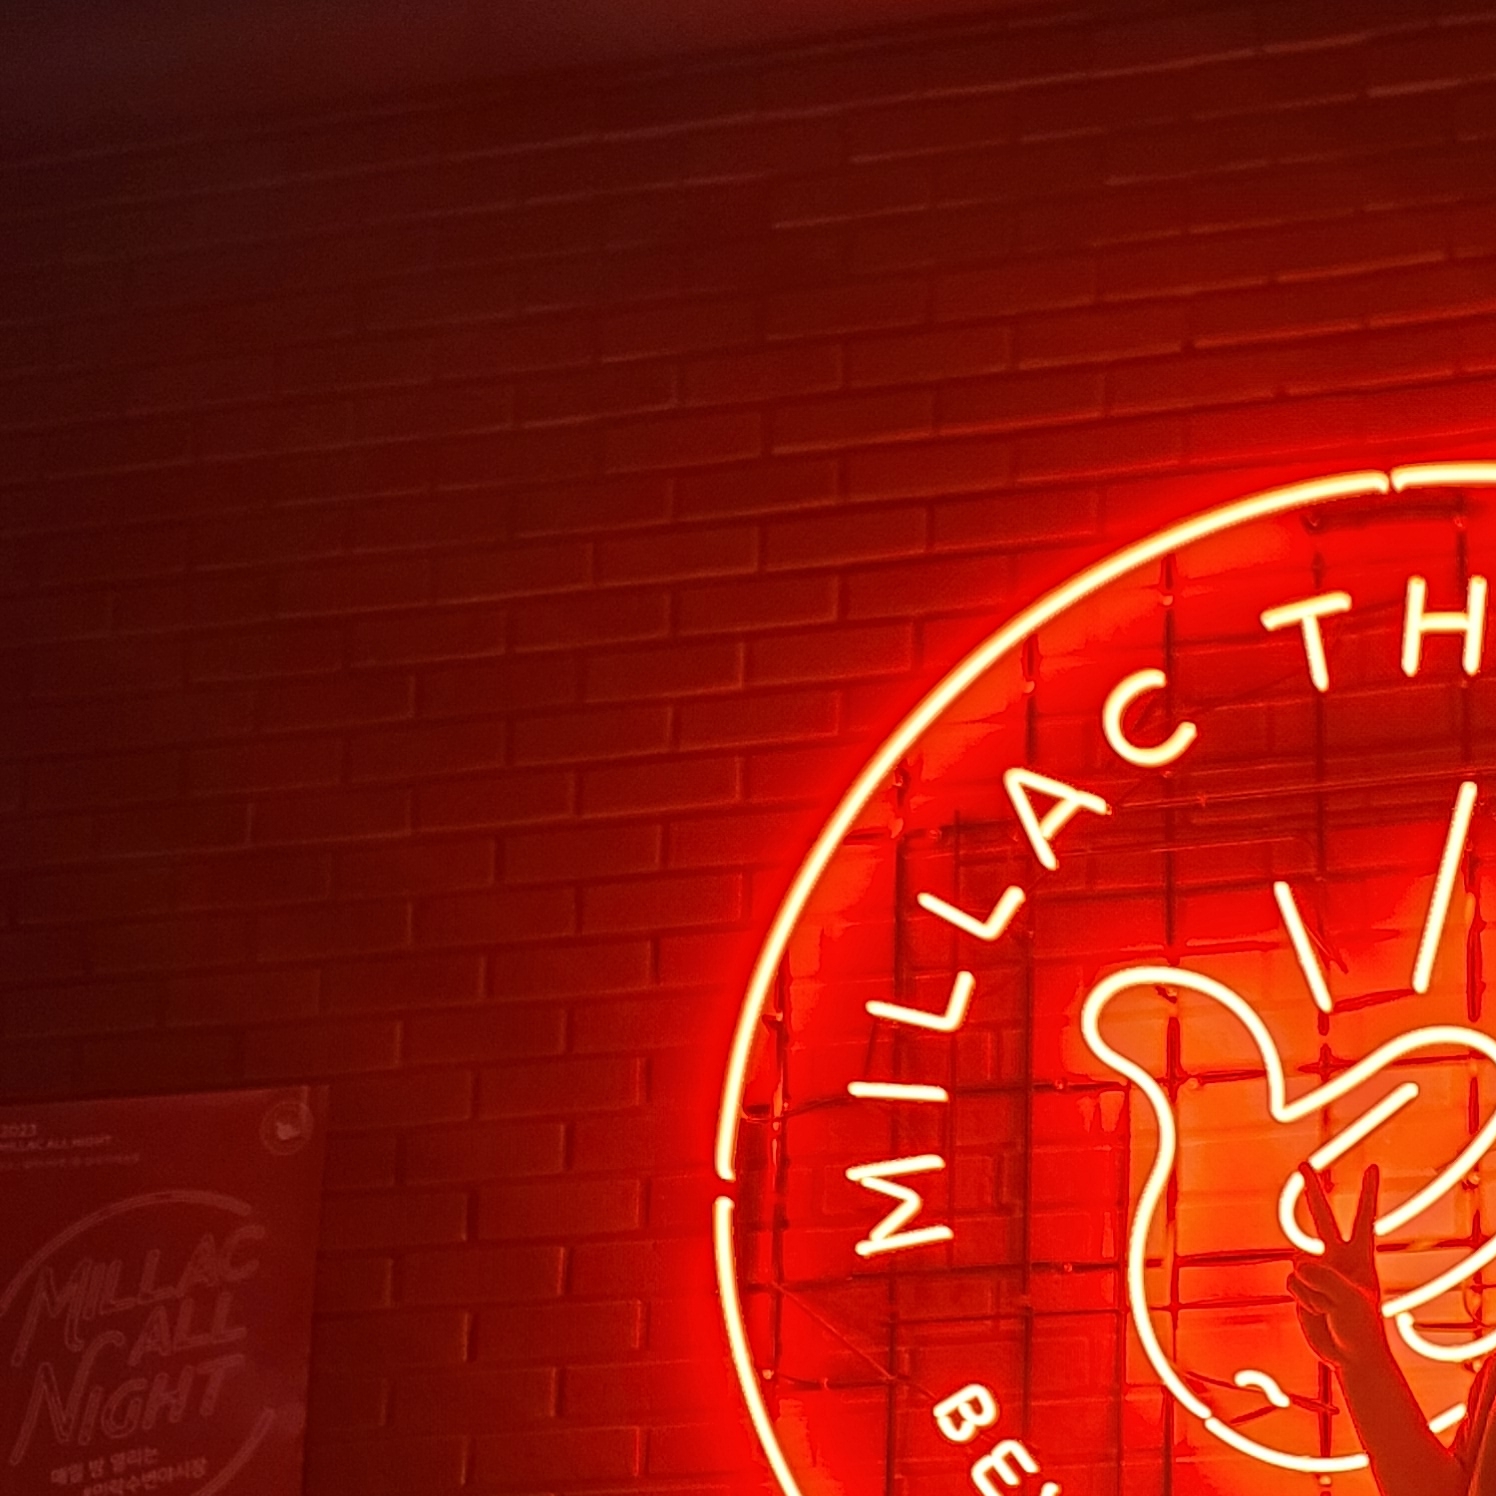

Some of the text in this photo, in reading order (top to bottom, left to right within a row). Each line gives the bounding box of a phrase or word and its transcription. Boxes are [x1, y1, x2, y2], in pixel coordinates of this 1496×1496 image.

[844, 668, 1198, 1258] MILLAC
[0, 1123, 37, 1138] 2023
[11, 1225, 266, 1367] MILLAC
[127, 1291, 248, 1367] ALL
[8, 1330, 246, 1466] NIGHT
